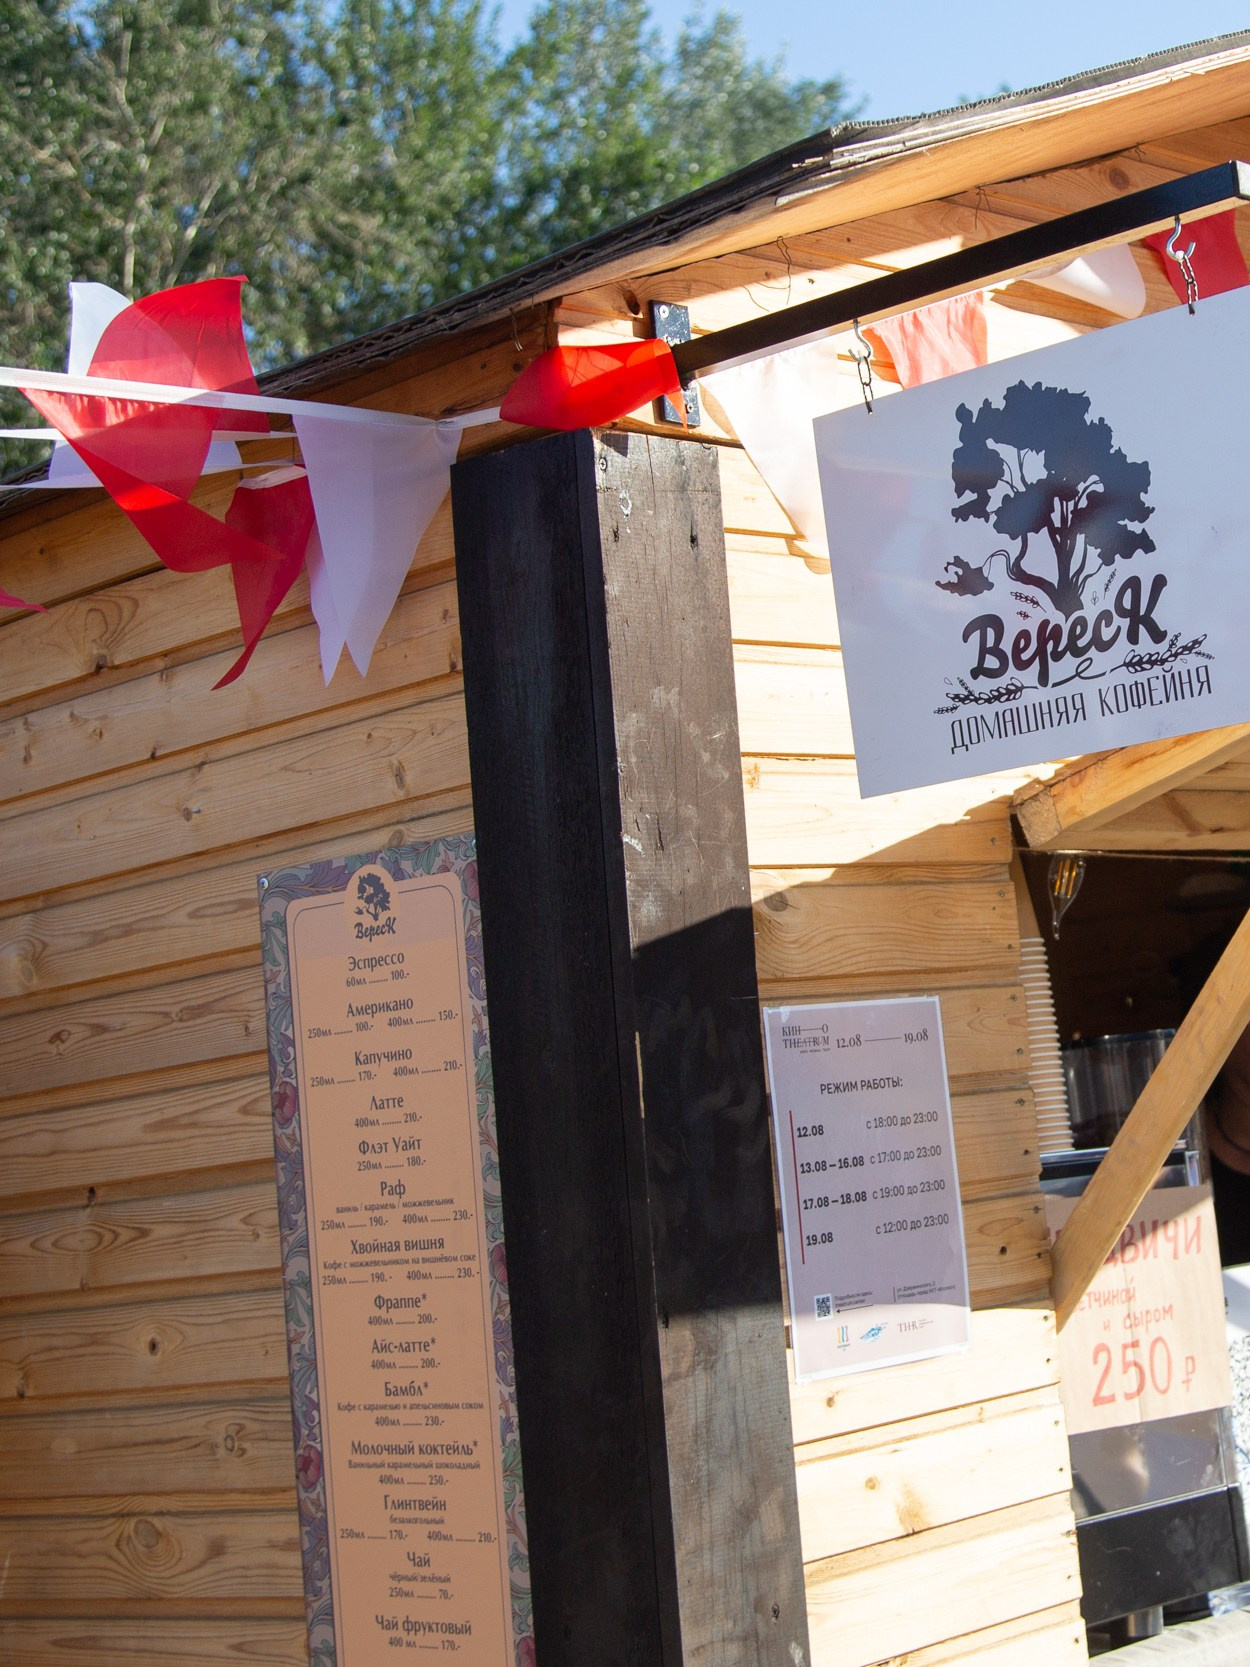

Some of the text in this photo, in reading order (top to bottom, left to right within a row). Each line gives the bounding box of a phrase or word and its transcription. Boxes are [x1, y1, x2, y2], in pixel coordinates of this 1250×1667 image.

[962, 574, 1168, 687] ВересК
[951, 665, 1212, 755] ДОМАШНЯЯ КОФЕЙНЯ
[354, 917, 396, 942] ВересК
[348, 953, 404, 972] Эспрессо
[346, 977, 366, 987] 60мл
[346, 998, 413, 1018] Американо
[308, 1028, 332, 1039] 250мл
[388, 1017, 413, 1028] 400мл
[836, 1029, 929, 1048] 12.08 19.08
[355, 1049, 412, 1067] Капучино
[311, 1077, 334, 1087] 250мл
[393, 1066, 419, 1077] 400мл
[820, 1077, 903, 1095] РЕЖИМ РАБОТЫ:
[370, 1096, 404, 1111] Латте
[355, 1117, 380, 1128] 400мл
[797, 1111, 938, 1138] 12.08 с 18:00 до 23:00
[359, 1136, 422, 1155] Флэт Уайт
[357, 1161, 382, 1171] 250мл
[800, 1160, 827, 1174] 13.08
[838, 1156, 865, 1169] 16.08
[870, 1154, 875, 1164] с
[877, 1150, 901, 1164] 17:00
[904, 1151, 915, 1162] до
[916, 1145, 942, 1158] 23:00
[380, 1179, 405, 1199] Раф
[803, 1196, 830, 1210] 17.08
[840, 1191, 867, 1205] 18.08
[872, 1190, 878, 1200] с
[879, 1184, 904, 1199] 19:00
[907, 1186, 918, 1196] до
[920, 1179, 945, 1193] 23:00
[364, 1202, 396, 1212] карамель
[402, 1198, 454, 1208] можжевельник
[321, 1220, 345, 1230] 250мл
[402, 1214, 428, 1224] 400мл
[806, 1213, 949, 1246] 19.08 с 12:00 до 23:00
[351, 1237, 444, 1254] Хвойная вишня
[460, 1254, 476, 1262] соке
[322, 1276, 347, 1285] 250мл
[406, 1270, 432, 1281] 400мл
[1073, 1277, 1136, 1313] етчиной
[368, 1316, 393, 1325] 400мл
[1123, 1304, 1173, 1334] сыром
[371, 1359, 396, 1369] 400мл
[1092, 1336, 1172, 1407] 250
[375, 1417, 401, 1426] 400мл
[352, 1440, 415, 1455] Молочный
[379, 1475, 404, 1485] 400мл
[384, 1495, 446, 1511] Глинтвейн
[340, 1529, 365, 1539] 250мл
[427, 1531, 453, 1542] 400мл
[407, 1552, 430, 1568] Чай
[389, 1587, 414, 1598] 250мл
[375, 1615, 472, 1636] Чай фруктовый
